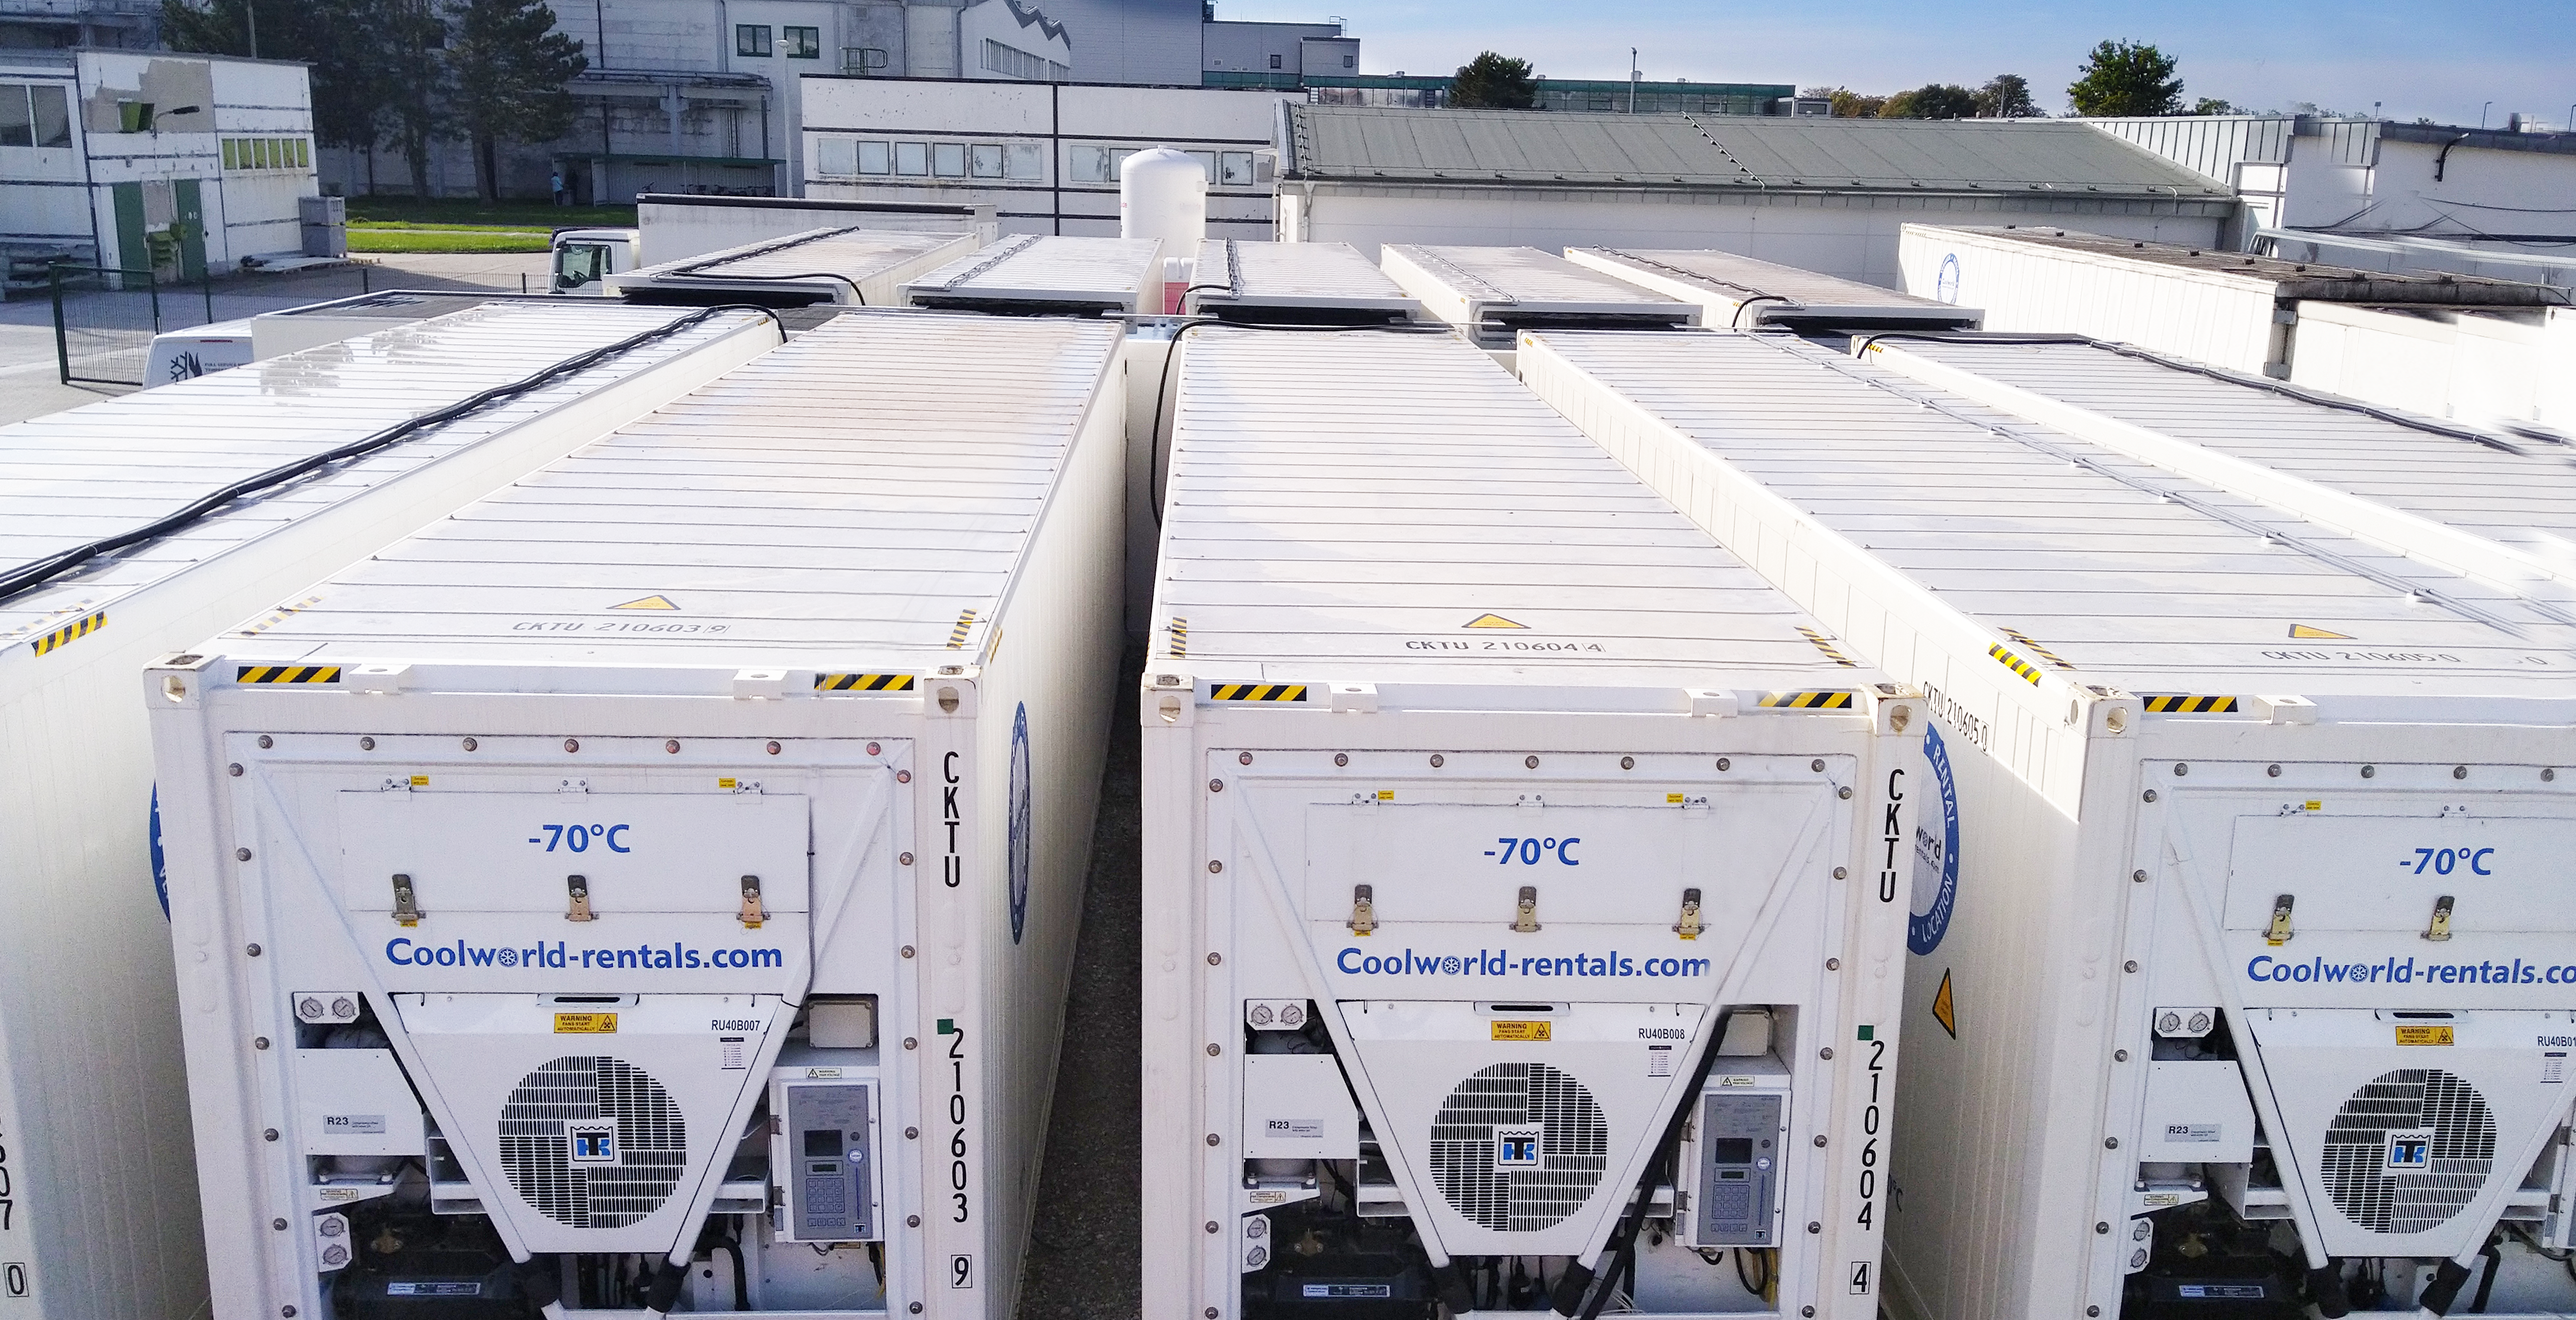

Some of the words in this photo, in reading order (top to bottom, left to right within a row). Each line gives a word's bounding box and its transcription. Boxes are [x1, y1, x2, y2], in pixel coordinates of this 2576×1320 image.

[512, 622, 584, 631] CKTU
[596, 622, 701, 633] 210603
[1405, 641, 1469, 650] CKTU
[1482, 641, 1578, 652] 210604
[2261, 650, 2331, 661] CKTU
[1922, 681, 1944, 718] CKTU
[1947, 697, 1979, 745] 210605
[1932, 744, 1955, 829] RENTAL
[944, 751, 961, 888] CKTU
[528, 824, 631, 854] -70°C
[1879, 768, 1905, 903] CKTU
[1484, 837, 1581, 866] -70°C
[2399, 848, 2495, 876] -70°C
[1921, 873, 1954, 943] LOCATION
[711, 1020, 761, 1031] RU40B007
[1638, 1028, 1685, 1039] RU40B008
[327, 1116, 349, 1126] R23
[949, 1028, 968, 1222] 210603
[1269, 1120, 1290, 1130] R23
[2168, 1126, 2189, 1134] R23
[1857, 1041, 1885, 1231] 210604
[954, 1257, 969, 1286] 9
[1852, 1263, 1868, 1292] 4
